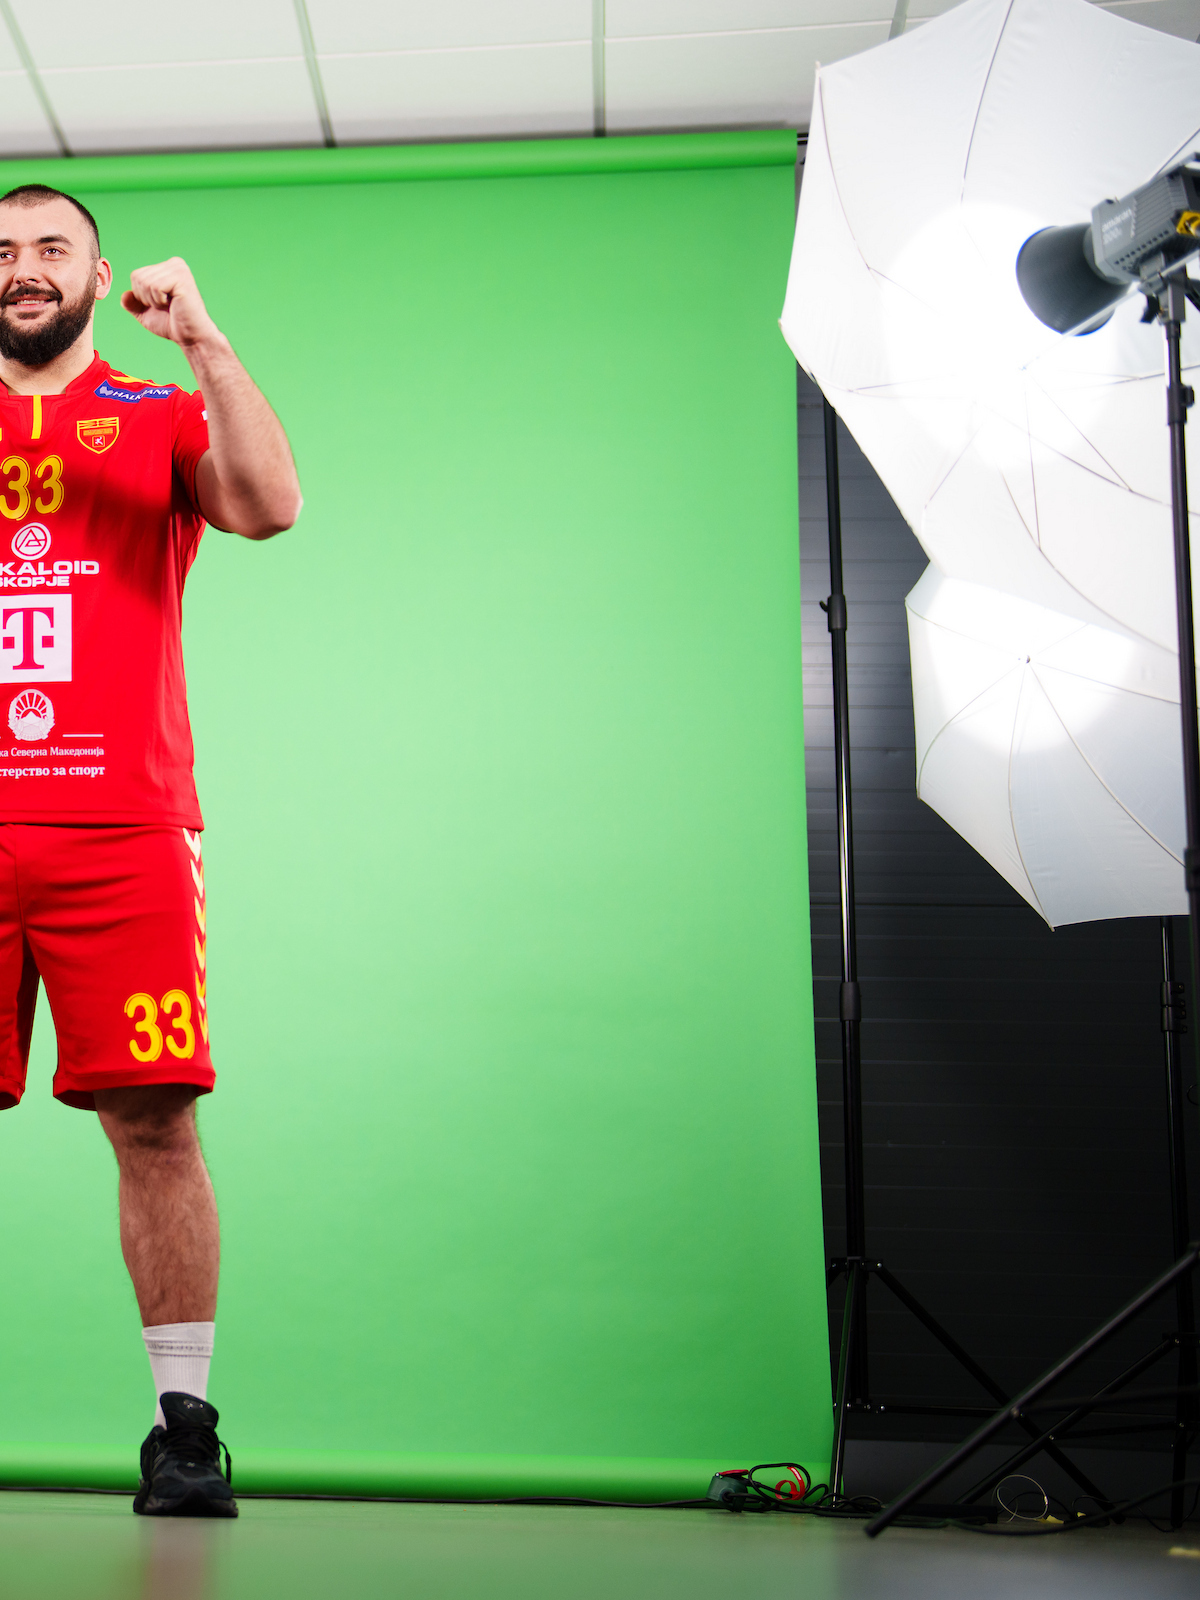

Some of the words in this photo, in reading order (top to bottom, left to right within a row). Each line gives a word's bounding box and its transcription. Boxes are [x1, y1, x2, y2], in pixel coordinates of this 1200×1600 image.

[10, 747, 48, 759] Северна
[49, 746, 105, 758] Македонија
[52, 767, 66, 776] за
[68, 765, 106, 779] спорт
[124, 988, 196, 1063] 33
